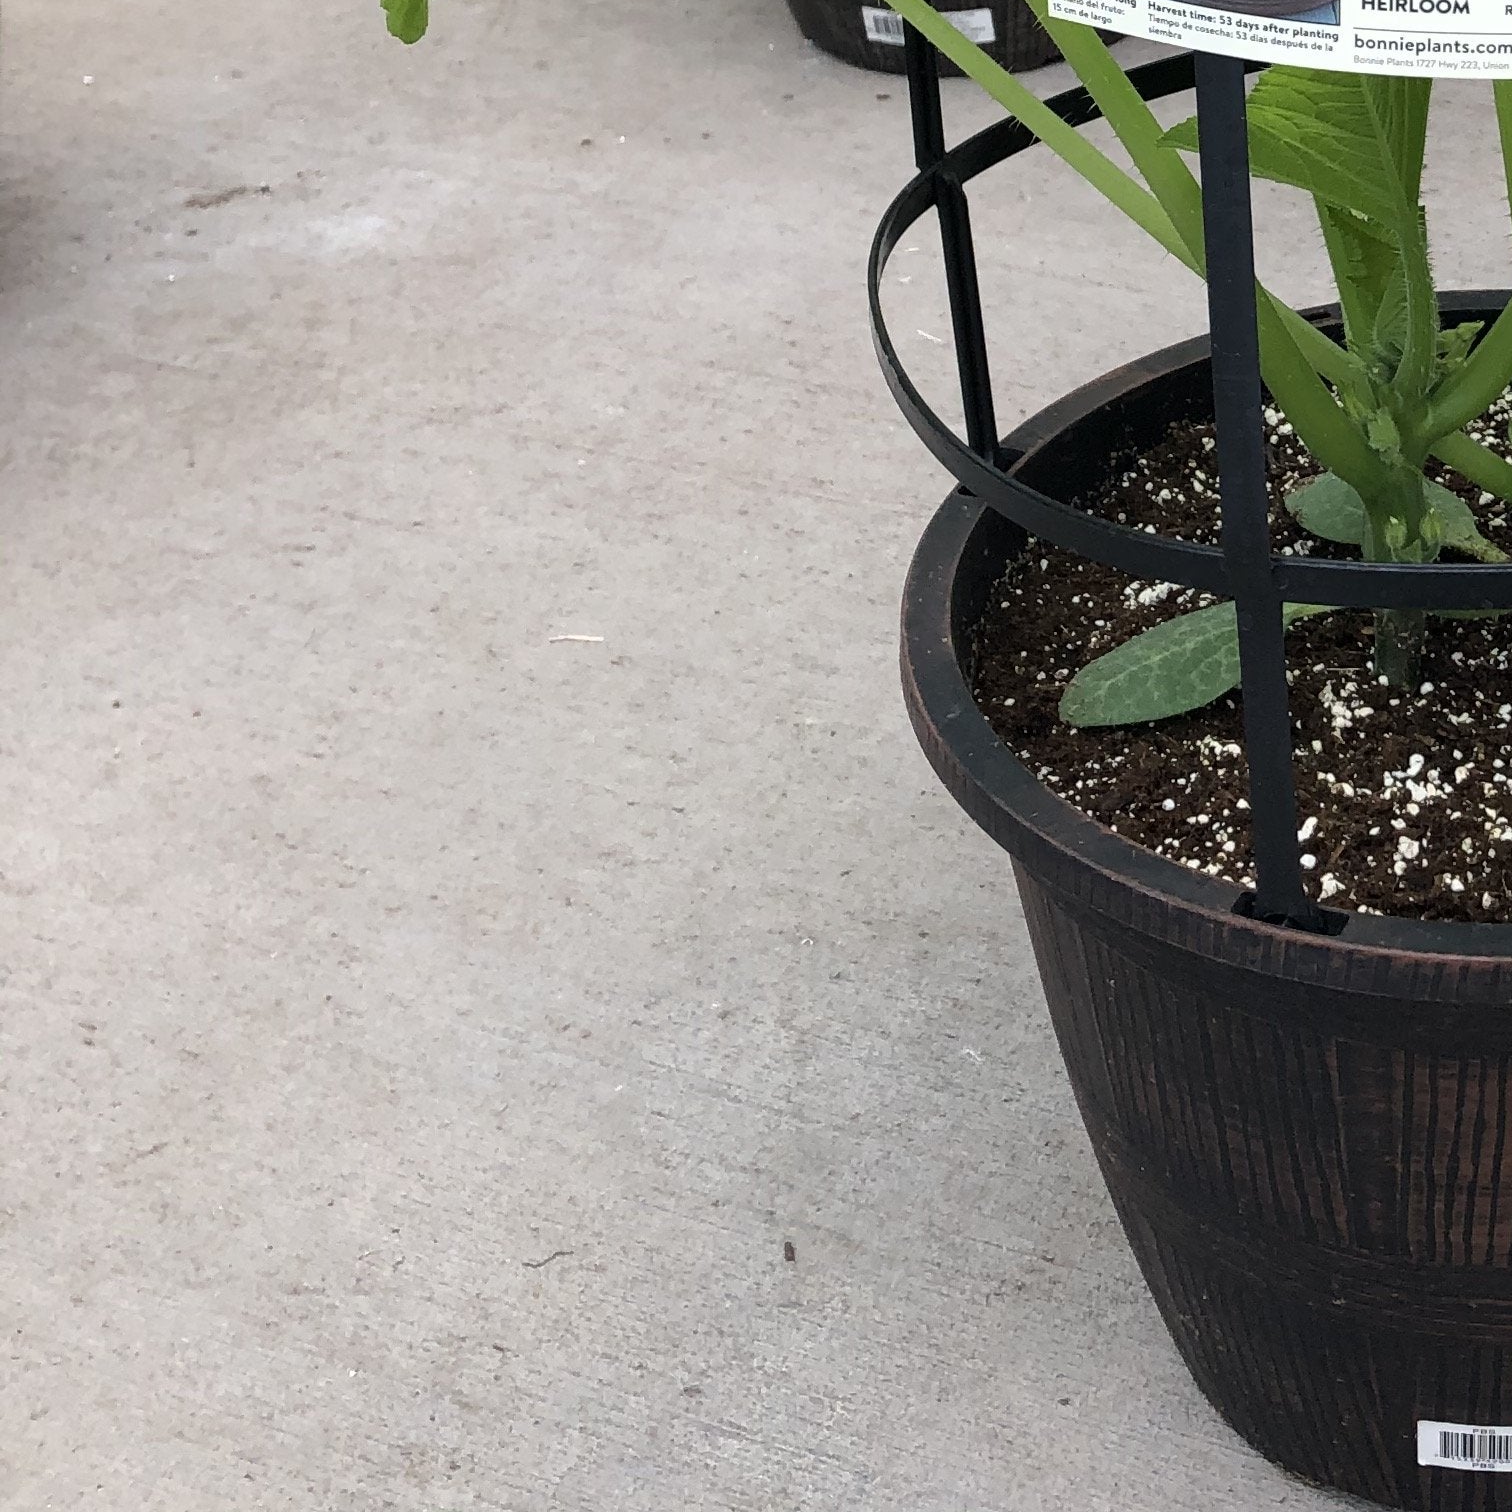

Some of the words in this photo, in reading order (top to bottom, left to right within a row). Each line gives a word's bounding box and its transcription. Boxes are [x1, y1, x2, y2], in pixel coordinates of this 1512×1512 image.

[1053, 3, 1062, 12] 15
[1064, 6, 1077, 15] cm
[1078, 9, 1088, 18] de
[1091, 11, 1112, 24] largo
[1148, 1, 1187, 18] Harvest
[1190, 9, 1216, 23] time:
[1219, 15, 1232, 26] 53
[1236, 19, 1260, 32] days
[1263, 23, 1290, 34] after
[1292, 27, 1339, 42] planting
[1148, 14, 1180, 29] Tiempo
[1182, 20, 1193, 30] de
[1236, 31, 1247, 40] 53
[1311, 41, 1322, 50] de
[1325, 43, 1333, 51] la
[1354, 55, 1384, 65] Bonnie
[1387, 57, 1413, 67] Plants
[1416, 59, 1436, 68] 1727
[1439, 60, 1458, 70] Hwy
[1461, 61, 1480, 70] 223,
[1482, 61, 1509, 69] Union
